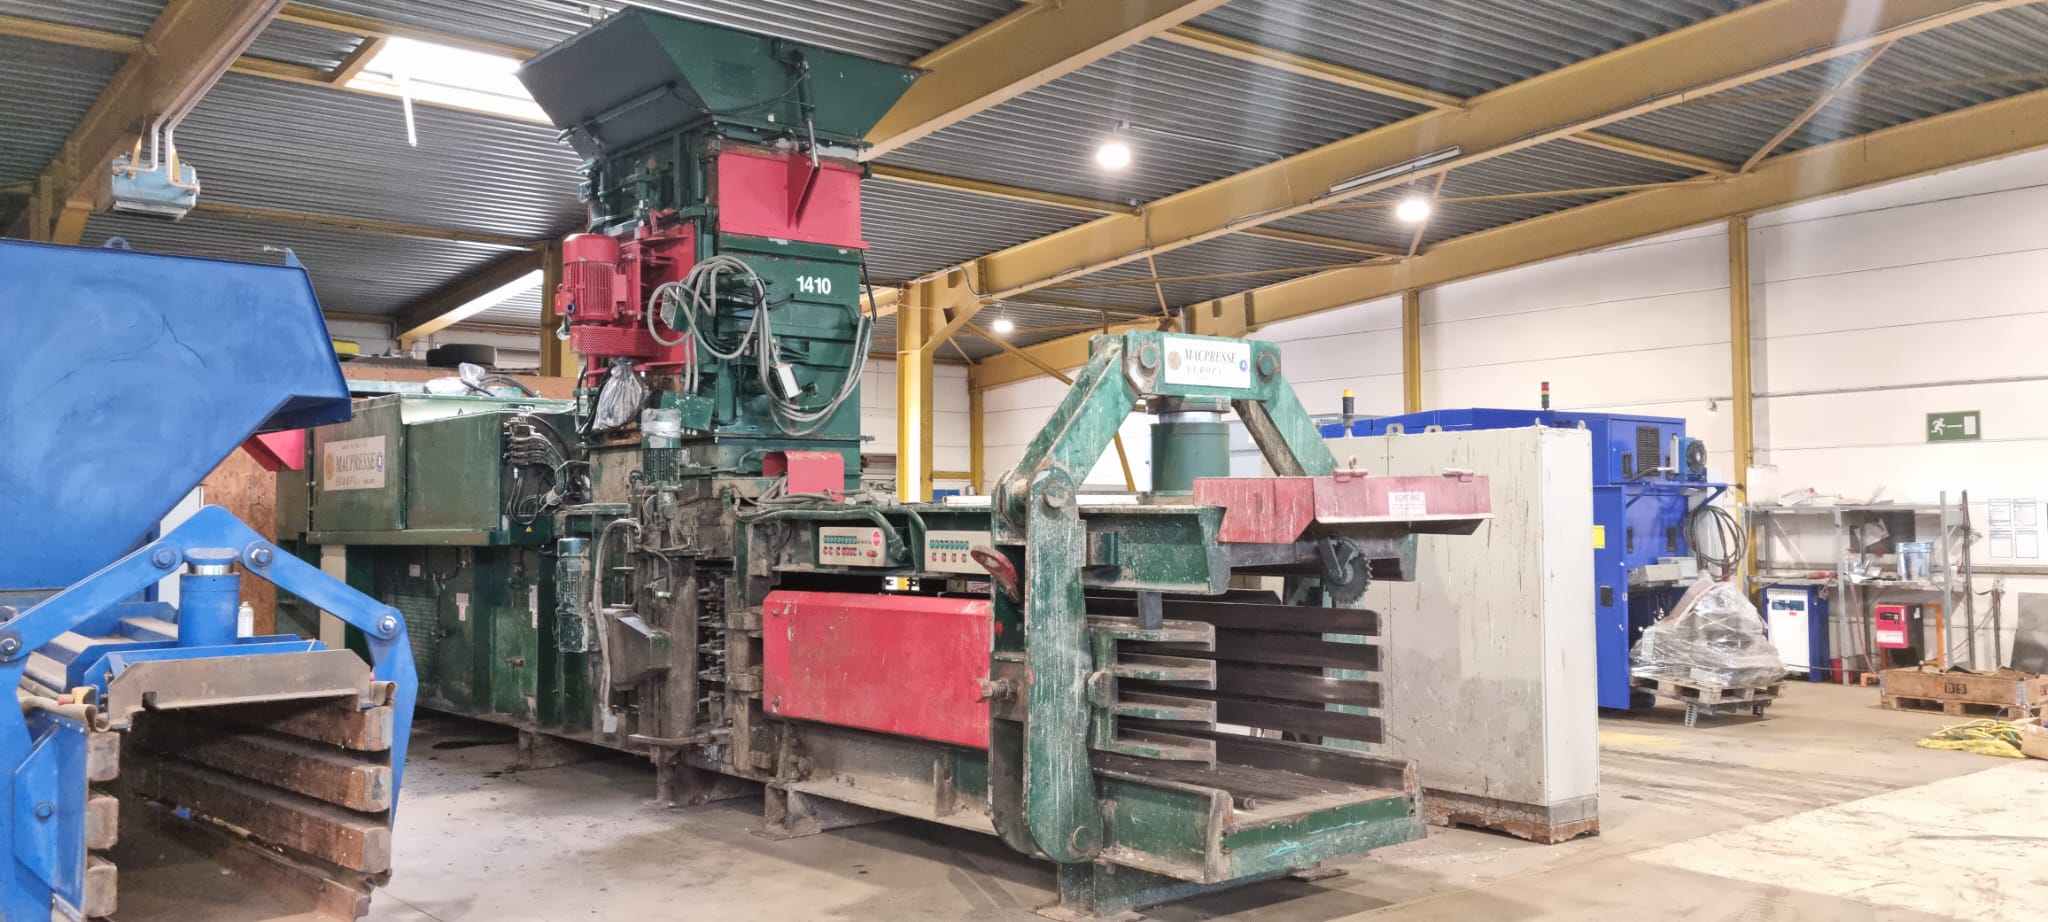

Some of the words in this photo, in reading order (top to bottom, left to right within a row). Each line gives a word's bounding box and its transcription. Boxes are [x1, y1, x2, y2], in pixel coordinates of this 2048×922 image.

[796, 275, 832, 295] 1410
[1184, 348, 1237, 364] MACPRESSE
[335, 452, 376, 473] MACPRESSE
